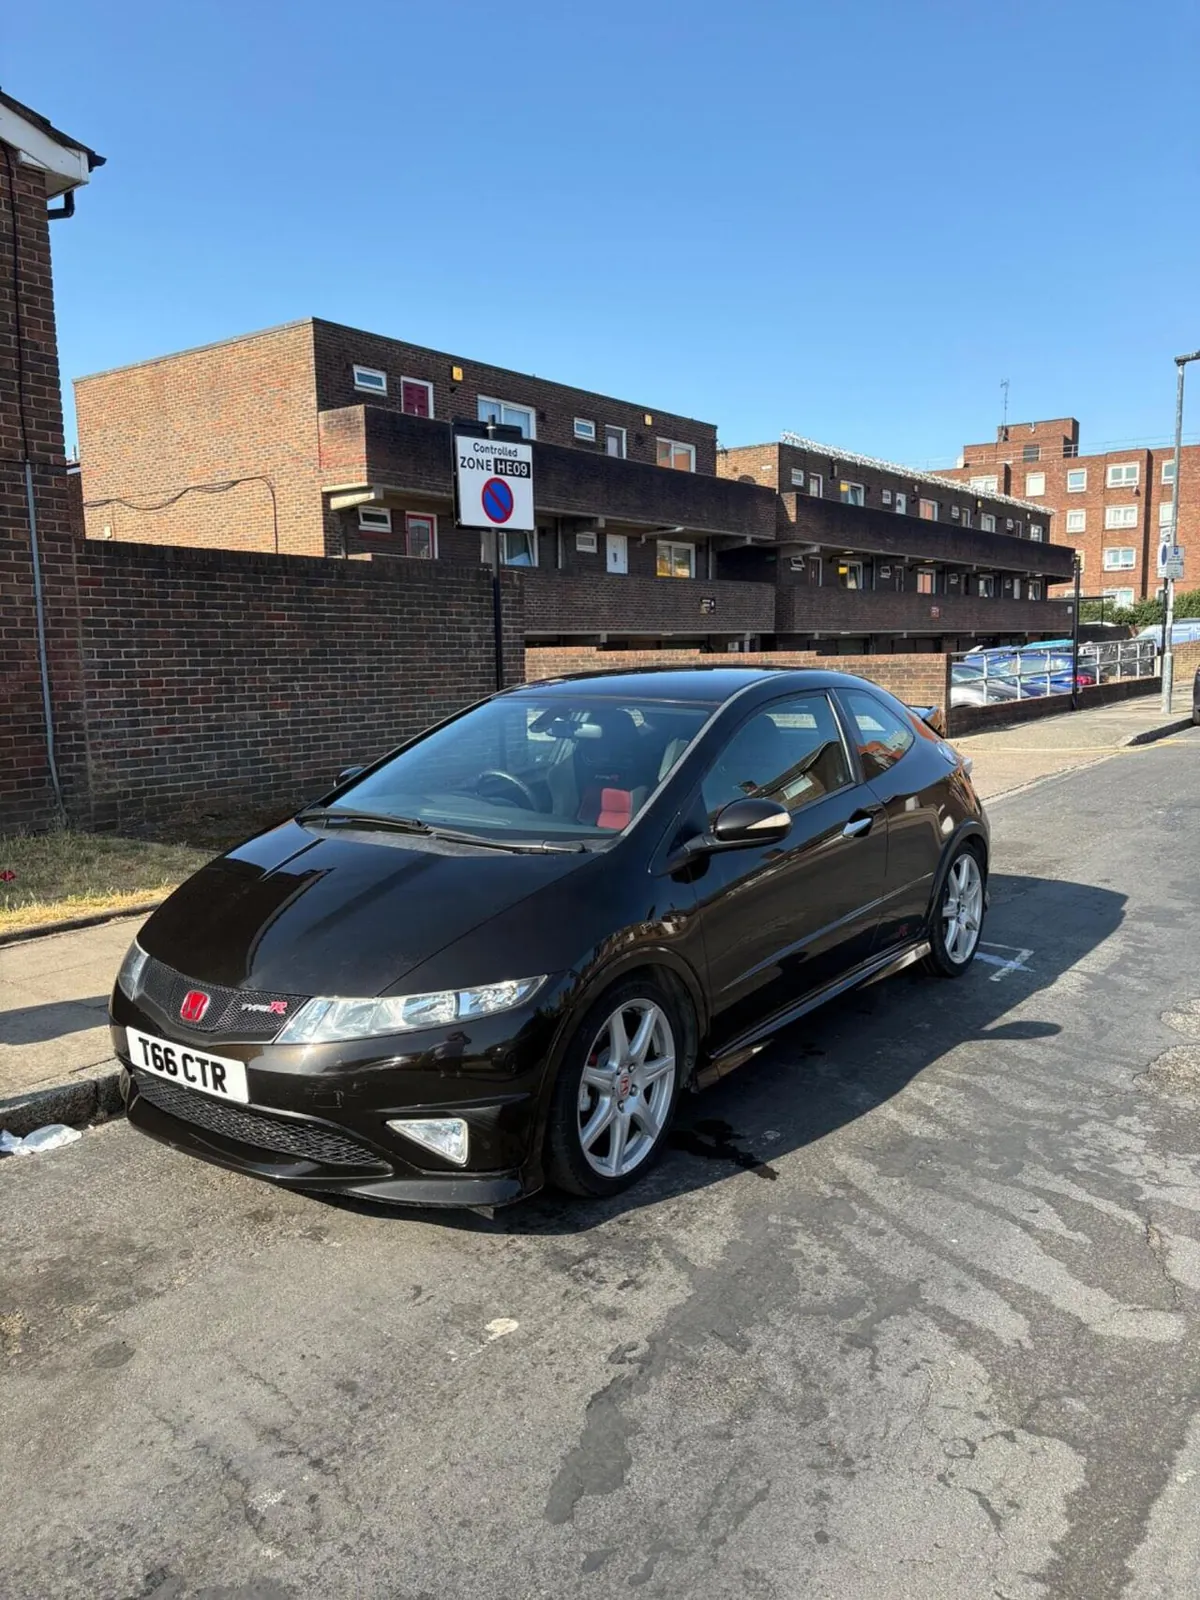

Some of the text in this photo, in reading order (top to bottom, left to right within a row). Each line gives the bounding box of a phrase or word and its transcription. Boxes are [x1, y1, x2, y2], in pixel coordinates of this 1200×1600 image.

[473, 442, 518, 457] Controlled
[460, 456, 528, 476] ZONE HE09
[138, 1037, 227, 1093] T66 CTR
